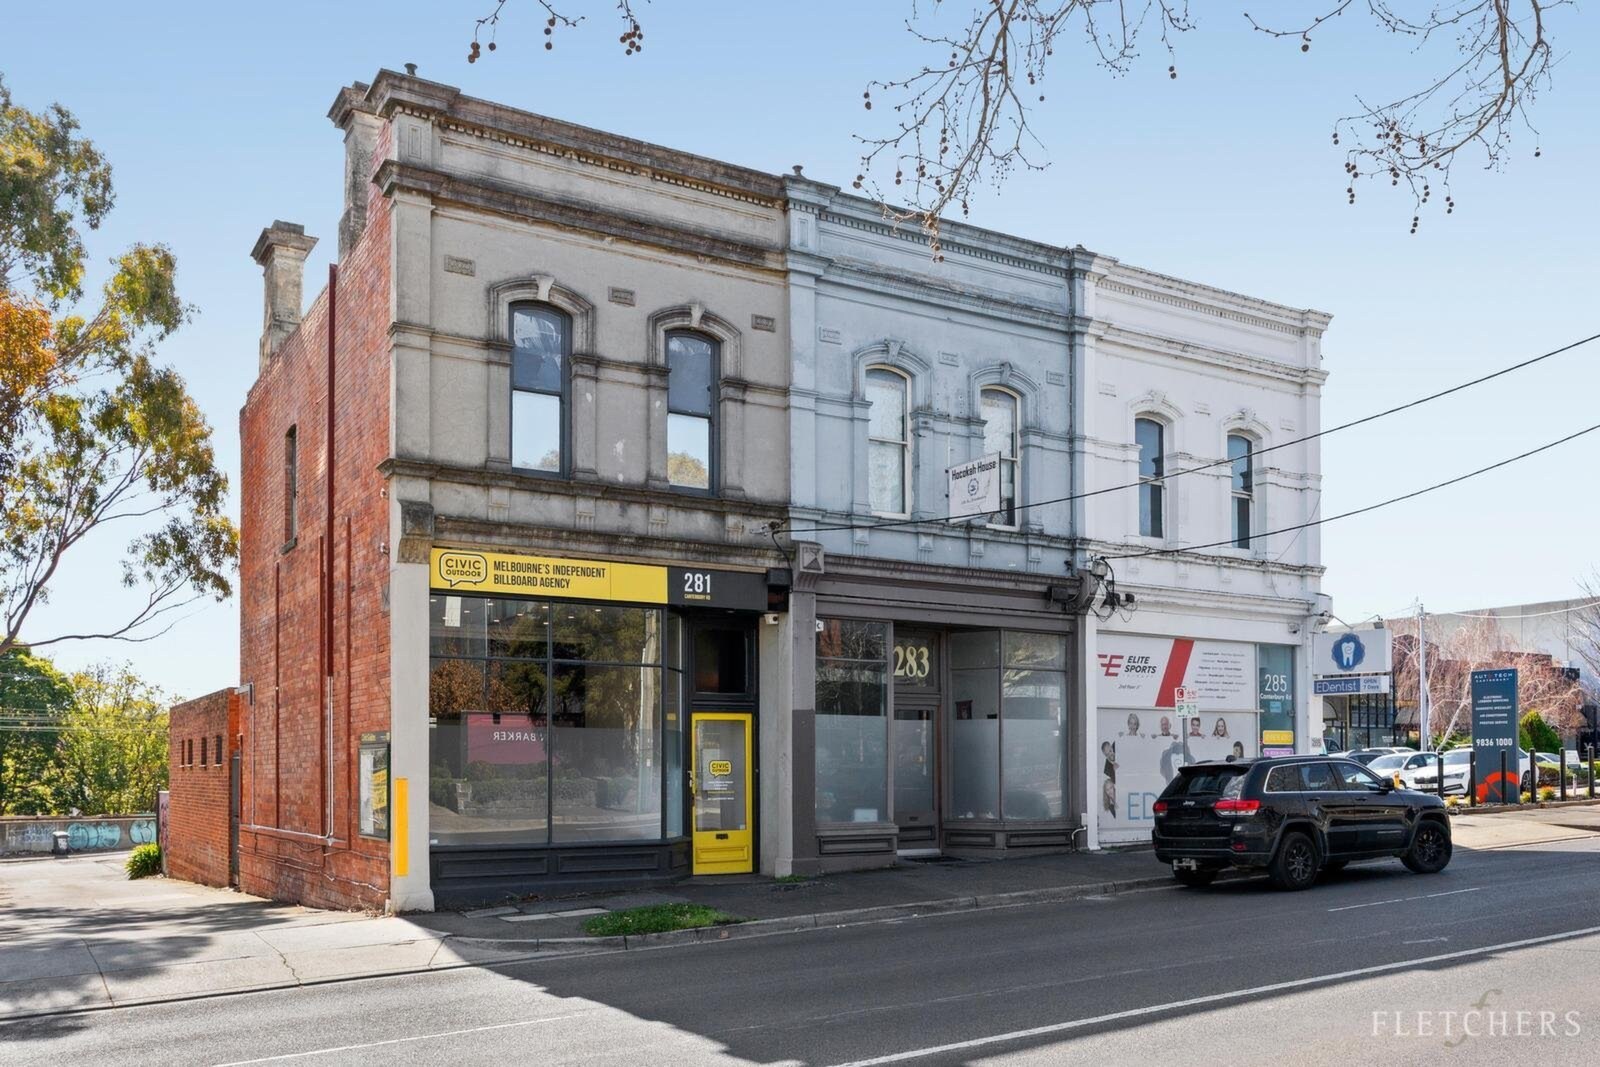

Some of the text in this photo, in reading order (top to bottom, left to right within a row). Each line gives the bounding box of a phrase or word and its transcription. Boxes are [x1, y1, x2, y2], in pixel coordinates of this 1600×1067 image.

[977, 461, 996, 473] House
[445, 558, 481, 570] CIVIC
[493, 561, 606, 579] MELBOURNE'S INDEPENDENT
[446, 569, 481, 578] OUTDOOR
[493, 574, 571, 589] BILLBOARD AGENCY
[684, 572, 711, 593] 281
[893, 646, 930, 678] 283
[1127, 655, 1150, 664] ELITE
[1124, 665, 1157, 674] SPORTS
[1264, 674, 1287, 692] 285
[1316, 681, 1357, 692] EDentist
[1260, 692, 1284, 701] Canterbury
[1475, 738, 1513, 746] 9836 1000
